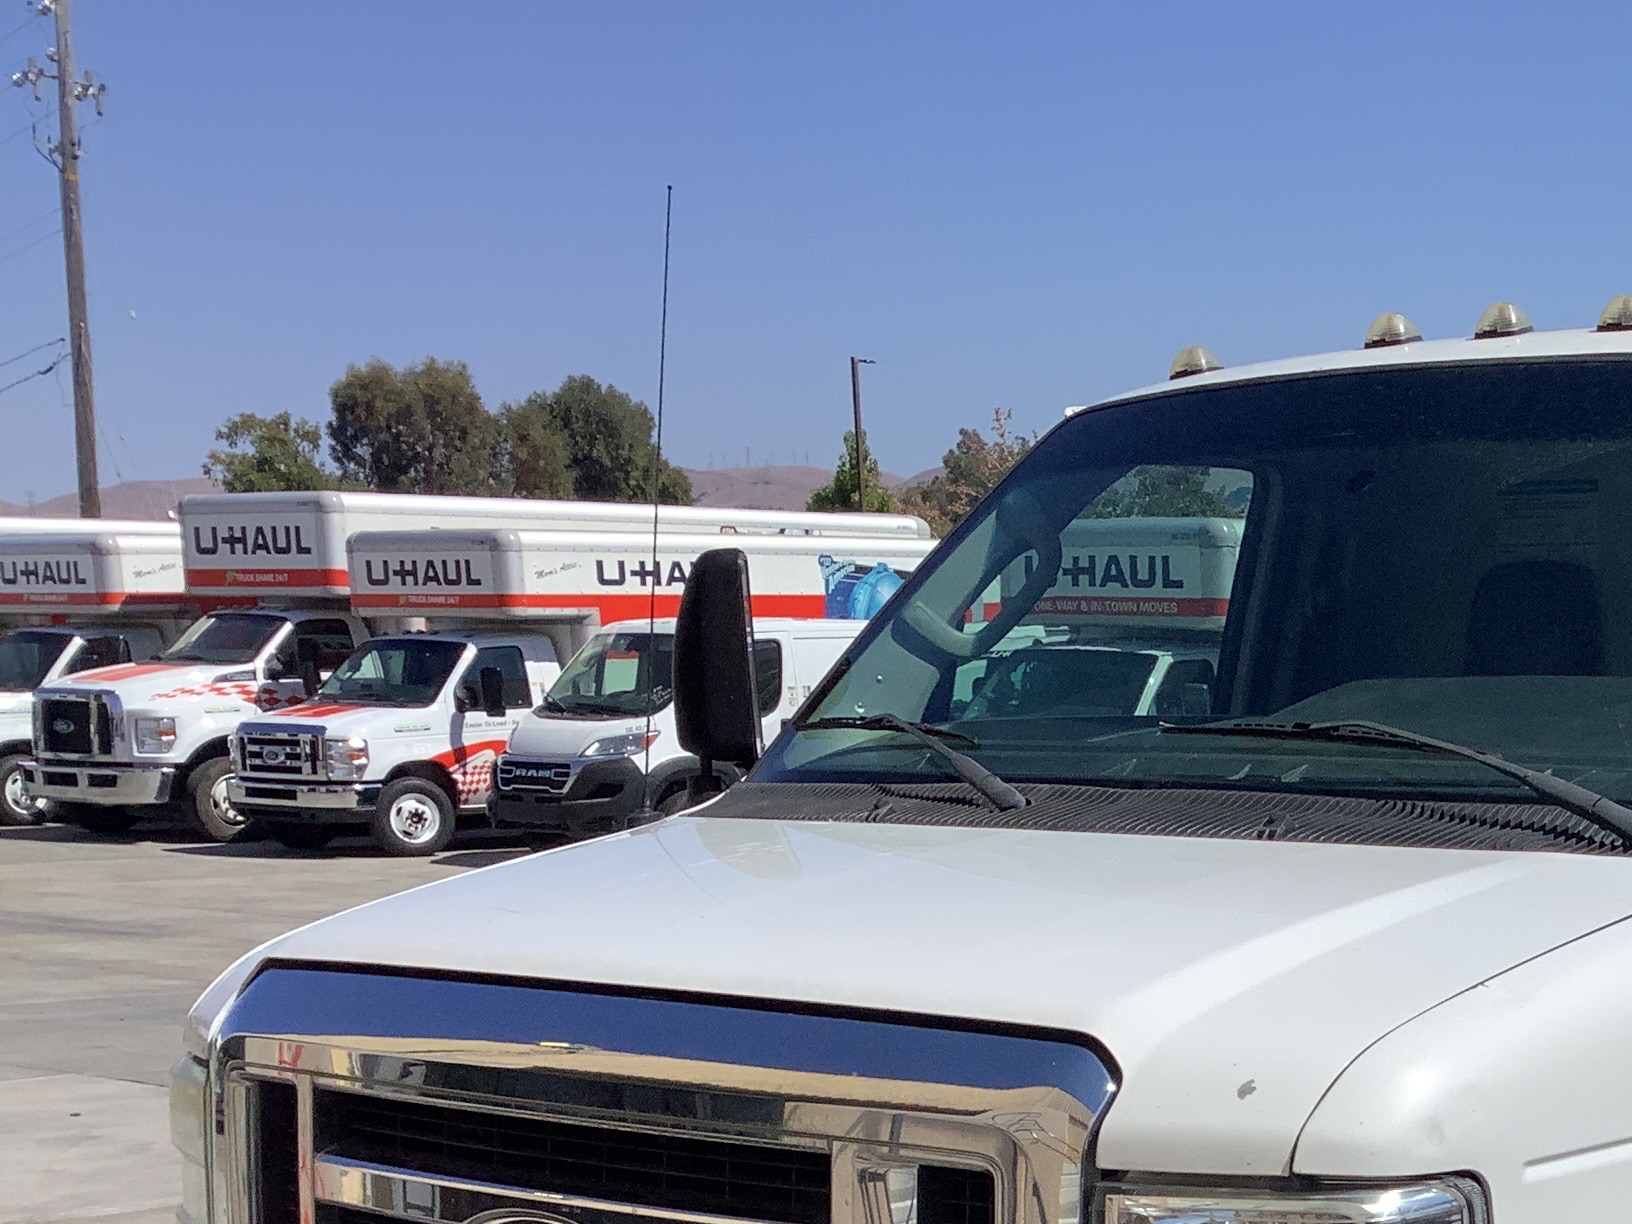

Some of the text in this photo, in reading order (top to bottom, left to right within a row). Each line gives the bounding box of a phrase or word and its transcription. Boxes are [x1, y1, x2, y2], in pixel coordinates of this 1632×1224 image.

[193, 525, 312, 555] U-HAUL
[0, 560, 87, 585] U-HAUL
[365, 558, 483, 586] U-HAUL
[595, 559, 696, 587] U-HA
[1139, 601, 1179, 614] MOVES
[514, 768, 552, 778] RAM
